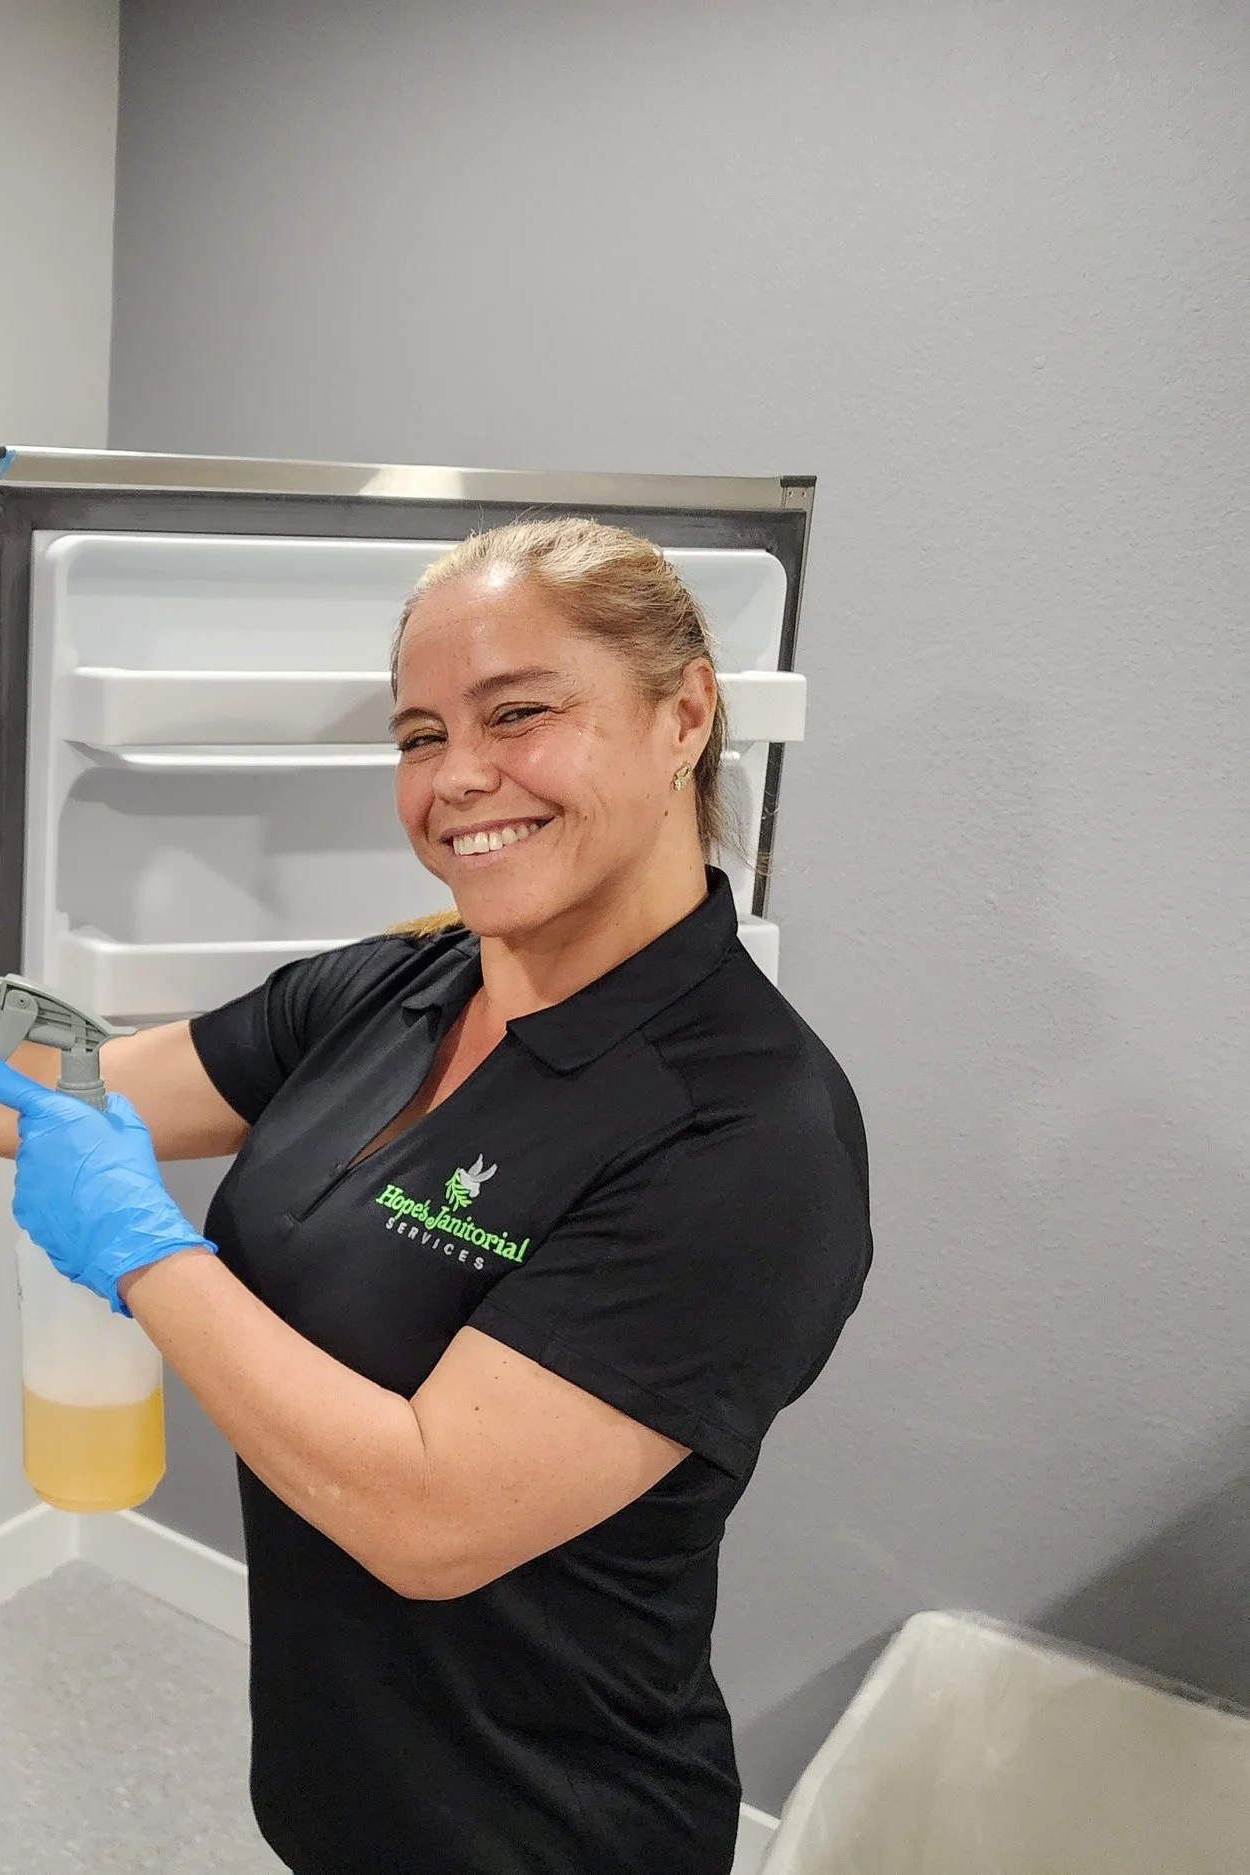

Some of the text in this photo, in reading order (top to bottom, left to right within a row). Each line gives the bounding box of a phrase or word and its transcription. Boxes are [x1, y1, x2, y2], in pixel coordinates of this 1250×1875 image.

[375, 1184, 531, 1263] Hope's Janitorial
[386, 1217, 485, 1270] SERVICES
